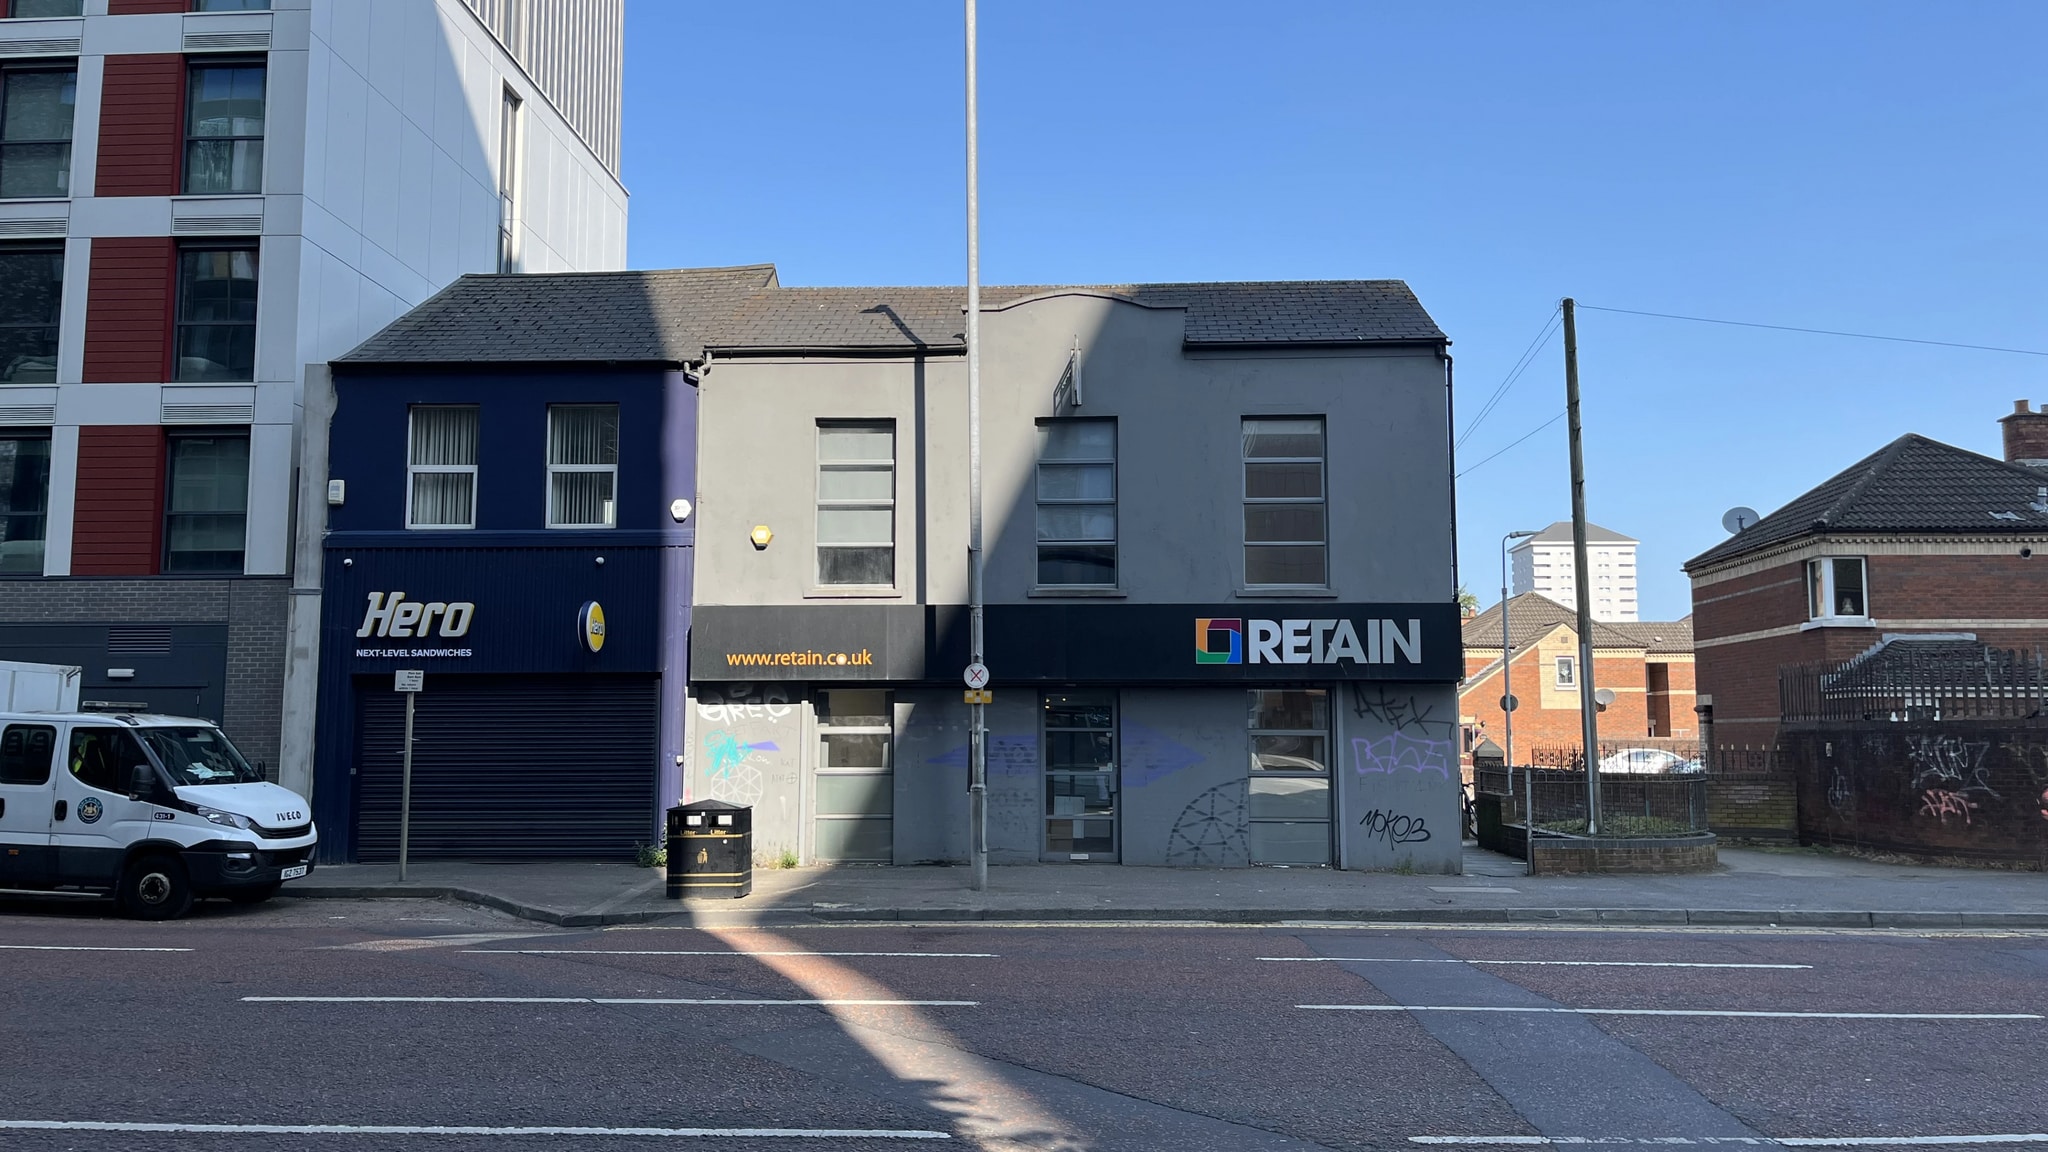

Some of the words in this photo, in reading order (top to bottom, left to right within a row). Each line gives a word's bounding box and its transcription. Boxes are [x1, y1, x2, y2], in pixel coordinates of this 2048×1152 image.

[355, 591, 476, 638] Hero
[1248, 618, 1422, 664] RETAIN
[356, 648, 409, 657] NEXT-LEVEL
[410, 648, 472, 657] SANDWICHES
[726, 648, 873, 666] www.retain.co.uk
[276, 810, 302, 822] IVECO
